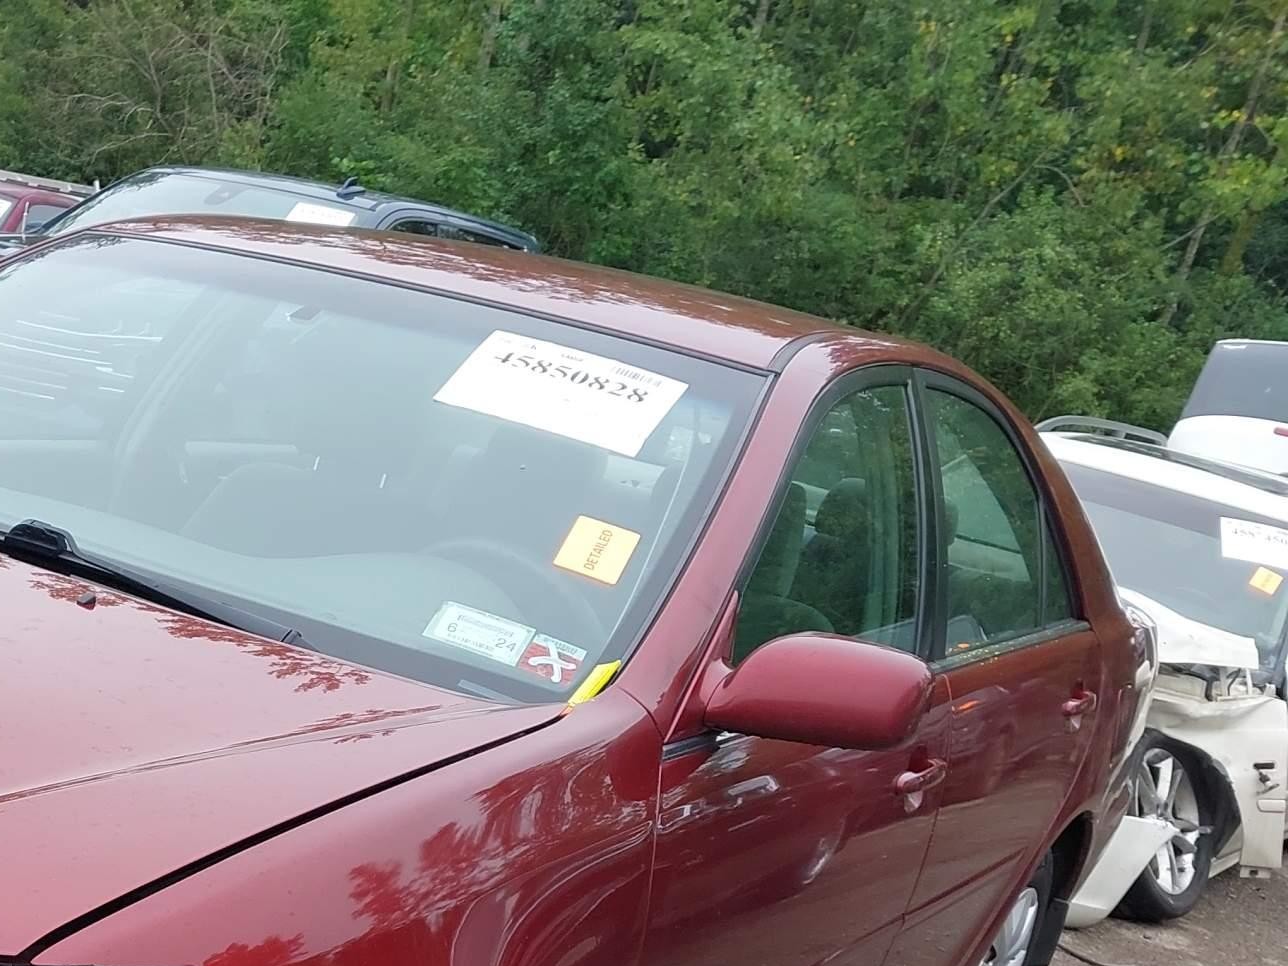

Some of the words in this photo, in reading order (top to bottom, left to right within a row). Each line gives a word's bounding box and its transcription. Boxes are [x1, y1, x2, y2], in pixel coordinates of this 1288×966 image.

[494, 352, 649, 403] 45850828
[583, 529, 614, 571] DETAILED
[447, 622, 458, 633] 6
[495, 637, 517, 652] 24
